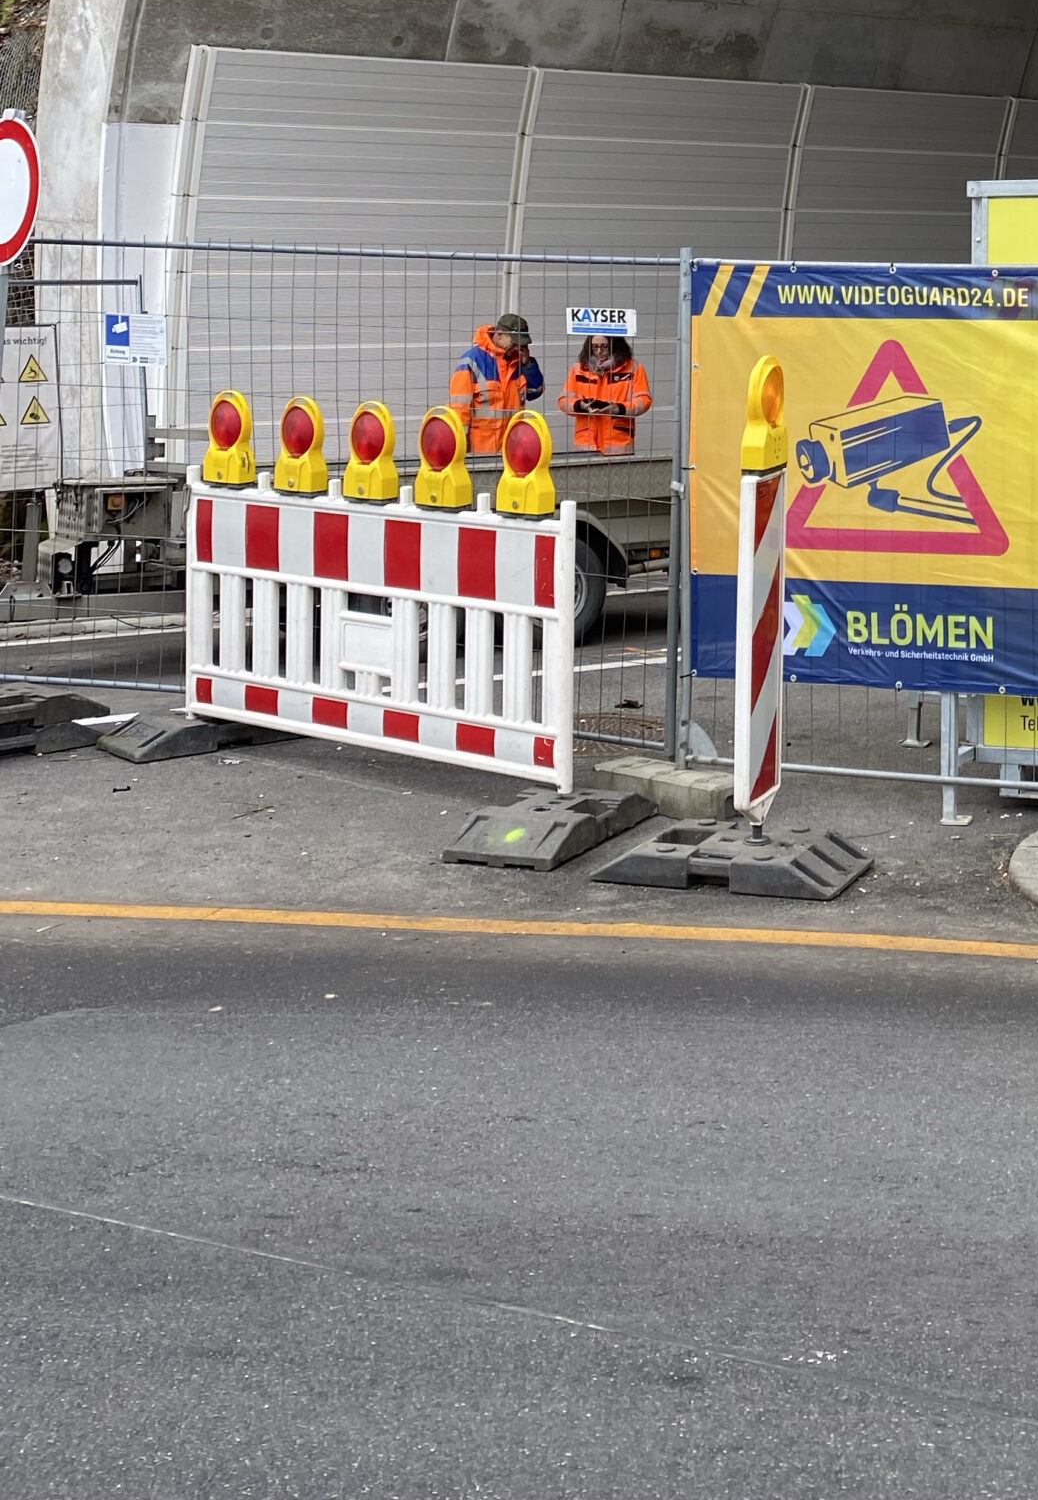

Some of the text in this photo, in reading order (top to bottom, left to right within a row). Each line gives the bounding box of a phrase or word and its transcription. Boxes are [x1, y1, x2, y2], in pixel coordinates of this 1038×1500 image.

[777, 284, 1029, 307] WWW.VIDEOGUARD24.DE
[571, 308, 627, 323] KAYSER
[846, 604, 994, 650] BLÖMEN
[847, 647, 994, 663] Verkehrs- und Sicherheitstechnik GmbH
